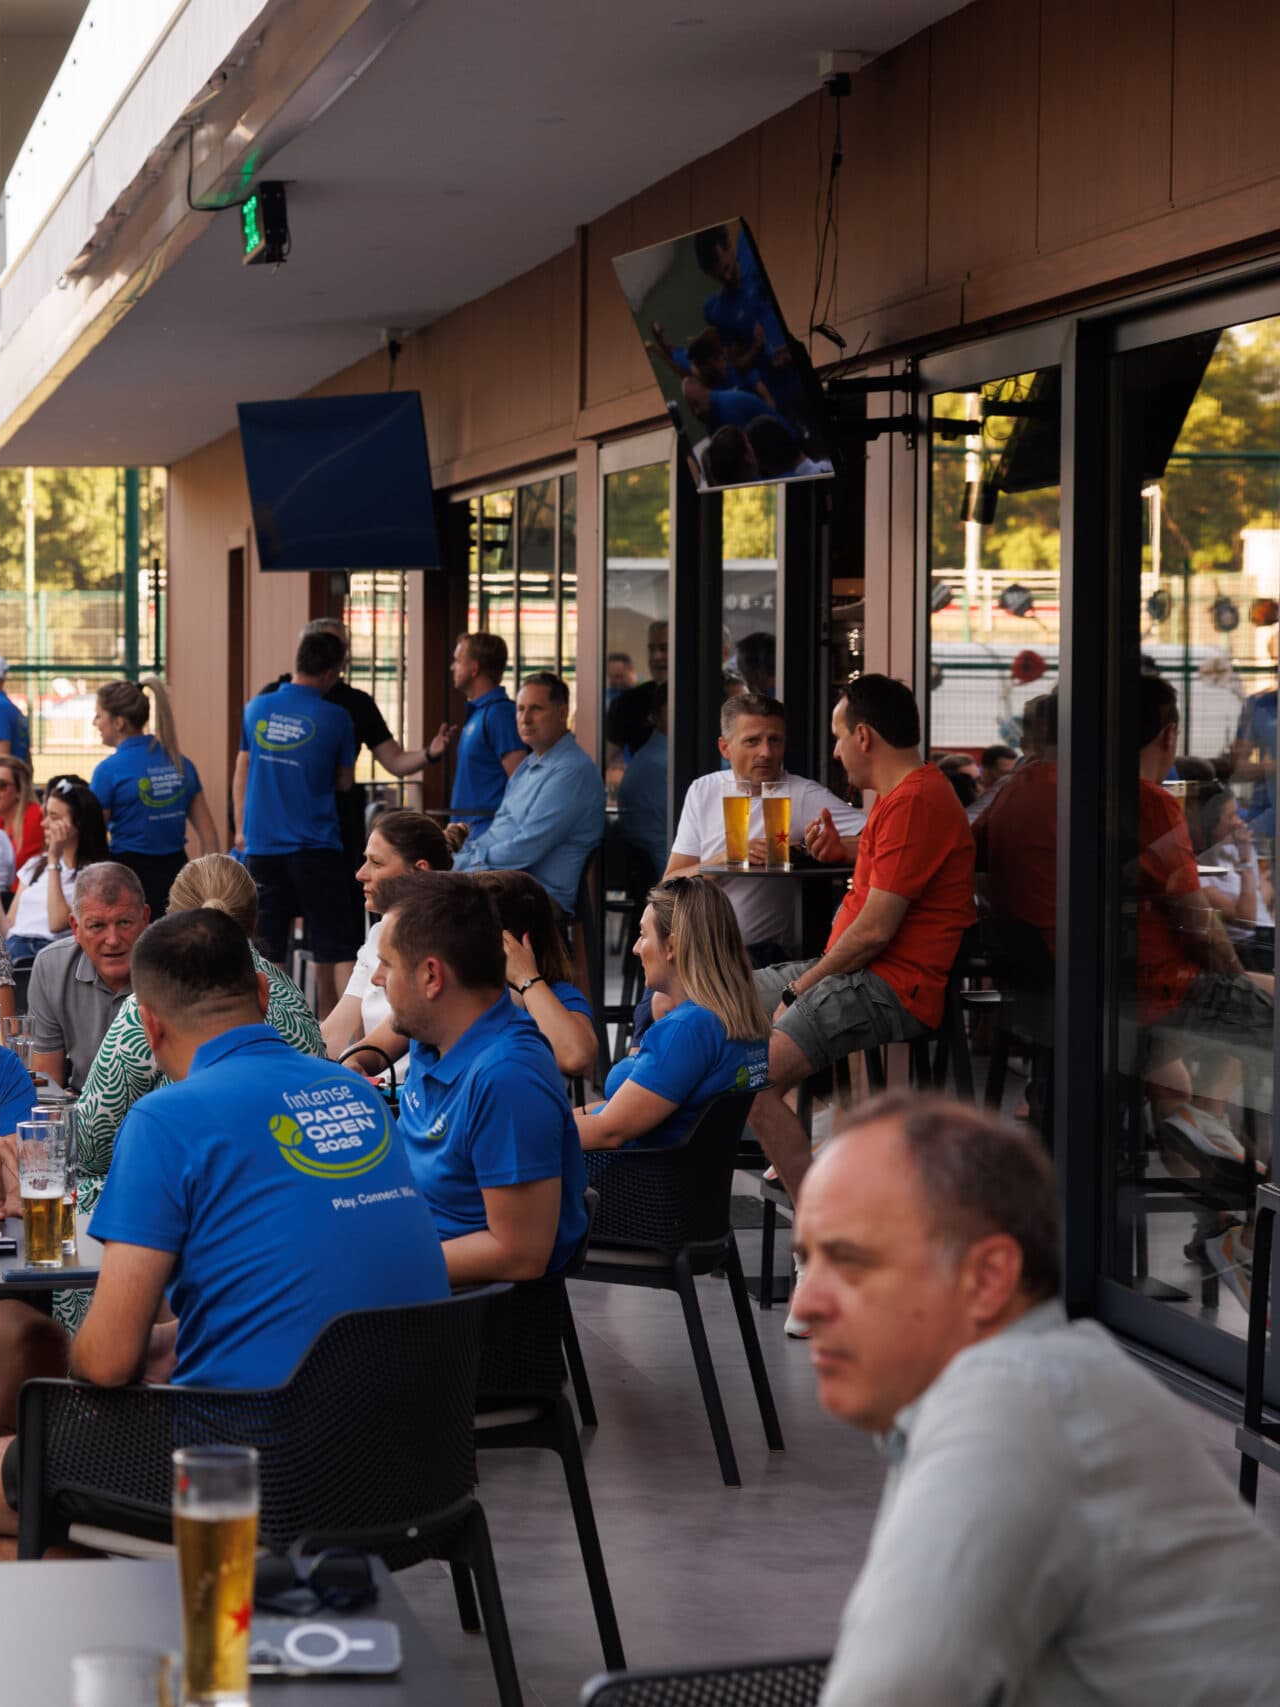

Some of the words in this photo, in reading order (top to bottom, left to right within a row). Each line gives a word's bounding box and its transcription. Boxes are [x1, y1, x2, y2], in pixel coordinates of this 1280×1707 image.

[282, 1085, 354, 1110] fintense
[296, 1101, 375, 1126] PADEL
[306, 1116, 376, 1141] OPEN
[315, 1135, 363, 1154] 2026
[332, 1197, 358, 1211] Play.
[358, 1188, 401, 1205] Connect.
